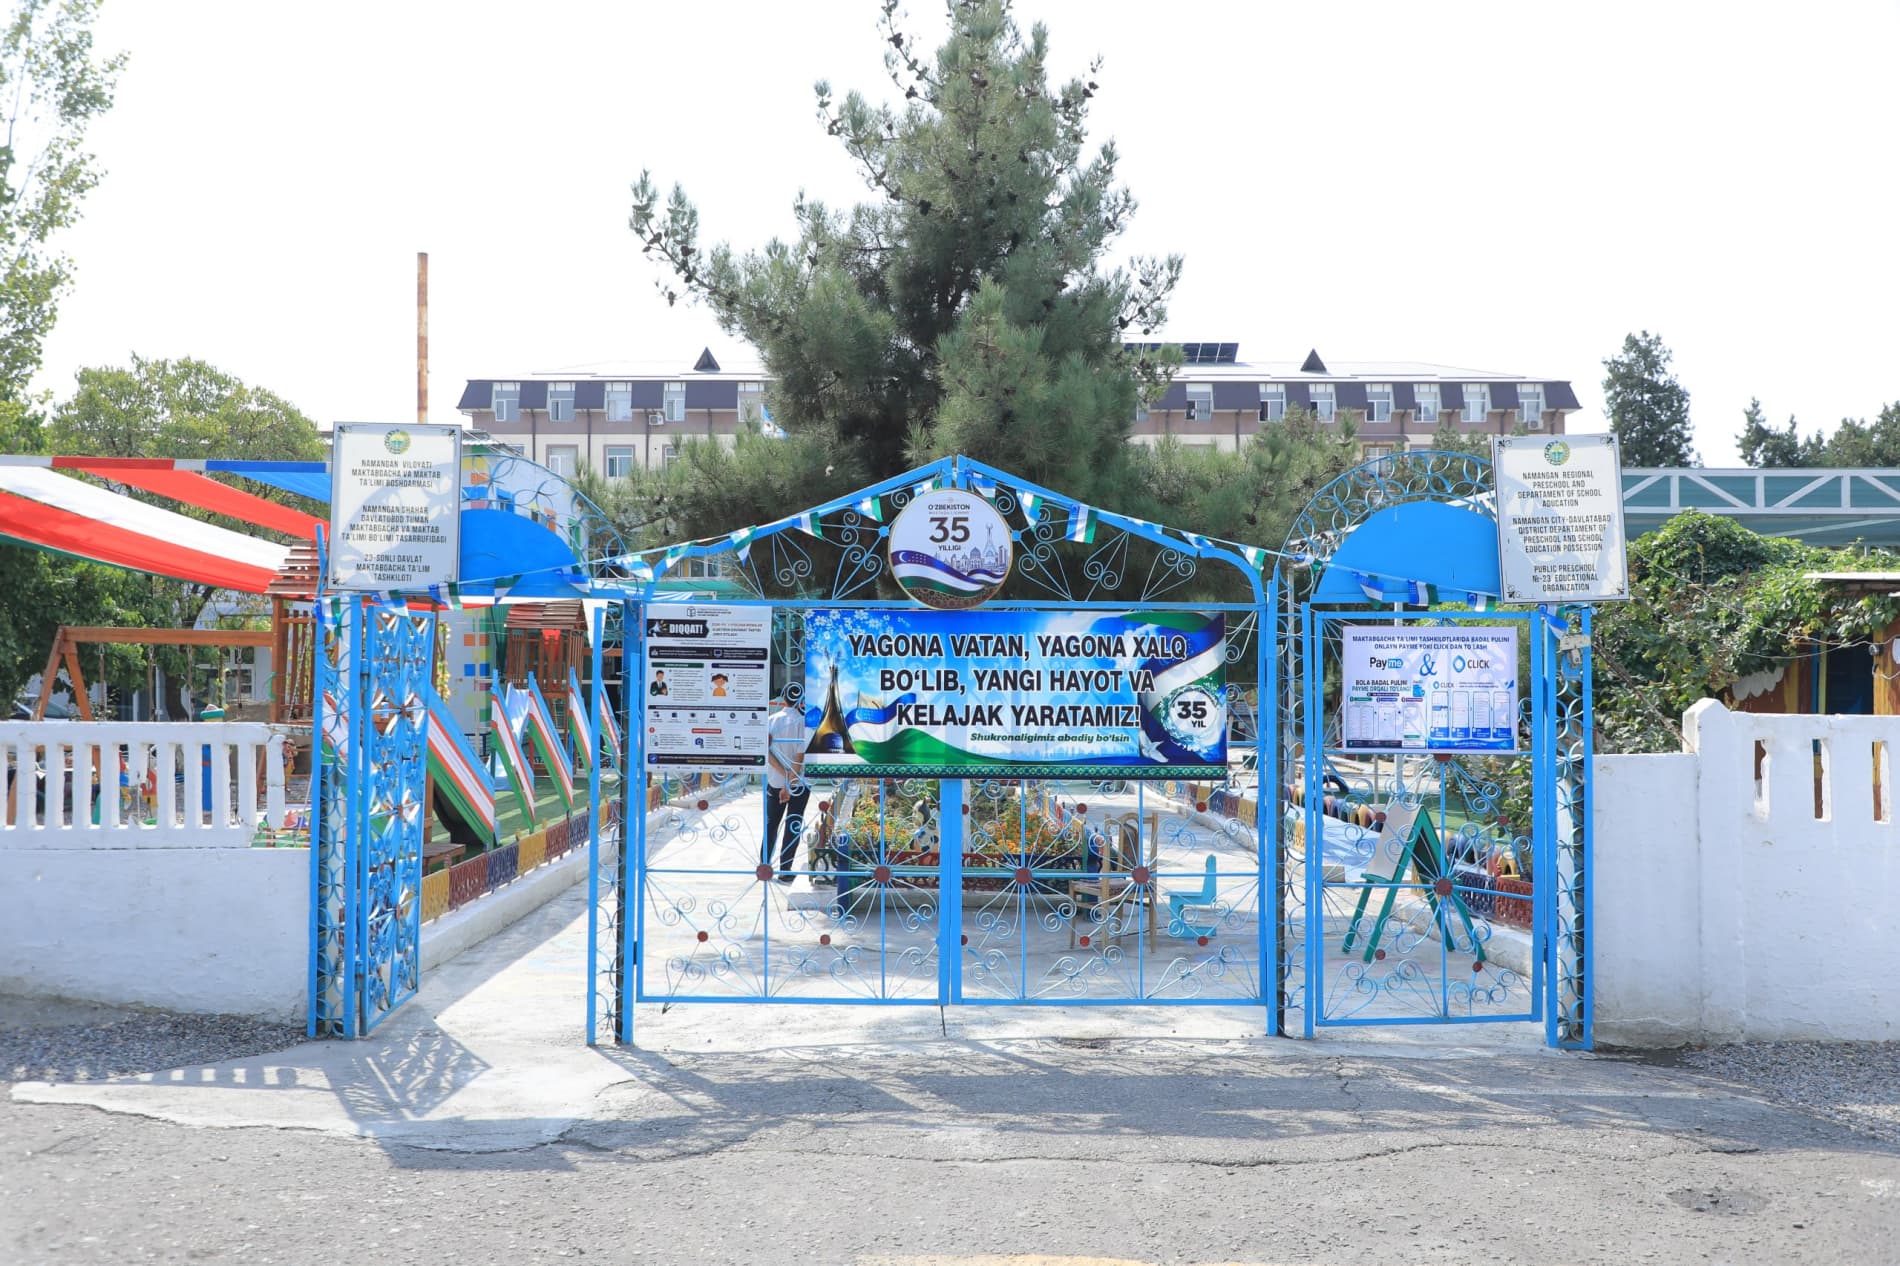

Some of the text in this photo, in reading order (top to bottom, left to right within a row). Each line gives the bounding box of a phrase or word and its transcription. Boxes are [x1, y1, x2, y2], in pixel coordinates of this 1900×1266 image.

[362, 460, 398, 468] NAMANGAN
[352, 469, 401, 477] MAKTABGACHA
[1572, 480, 1585, 488] AND
[1518, 489, 1602, 499] DEPARTAMENT OF SCHOOL
[363, 505, 399, 513] NAMANGAN
[1513, 517, 1549, 525] NAMANGAN
[350, 524, 399, 532] MAKTABGACHA
[412, 526, 439, 534] MAKTAB
[929, 517, 970, 543] 35
[1519, 524, 1606, 534] DISTRICT DEPARTAMENT OF
[1524, 536, 1560, 544] PRESCHOOL
[1578, 534, 1603, 542] SCHOOL
[1525, 544, 1602, 553] EDUCATION POSSESSION
[398, 555, 423, 563] DAVLAT
[357, 563, 406, 572] MAKTABGACHA
[1559, 564, 1596, 572] PRESCHOOL
[374, 573, 412, 582] TASHKILOTI
[1555, 574, 1598, 582] EDUCATIONAL
[1543, 584, 1589, 592] ORGANIZATION
[669, 624, 703, 635] DIQQAT!
[848, 634, 1187, 660] YAGONA VATAN, YAGONA XALQ
[1419, 653, 1437, 676] &
[1468, 660, 1490, 669] CLICK
[975, 670, 1041, 692] YANGI
[1050, 670, 1122, 692] HAYOT
[1130, 671, 1155, 693] VA
[1177, 701, 1207, 719] 35
[897, 704, 1140, 727] KELAJAK YARATAMIZ!
[1191, 720, 1206, 728] YIL
[970, 733, 1055, 744] Shukronaligimiz
[1058, 733, 1094, 744] abadiy
